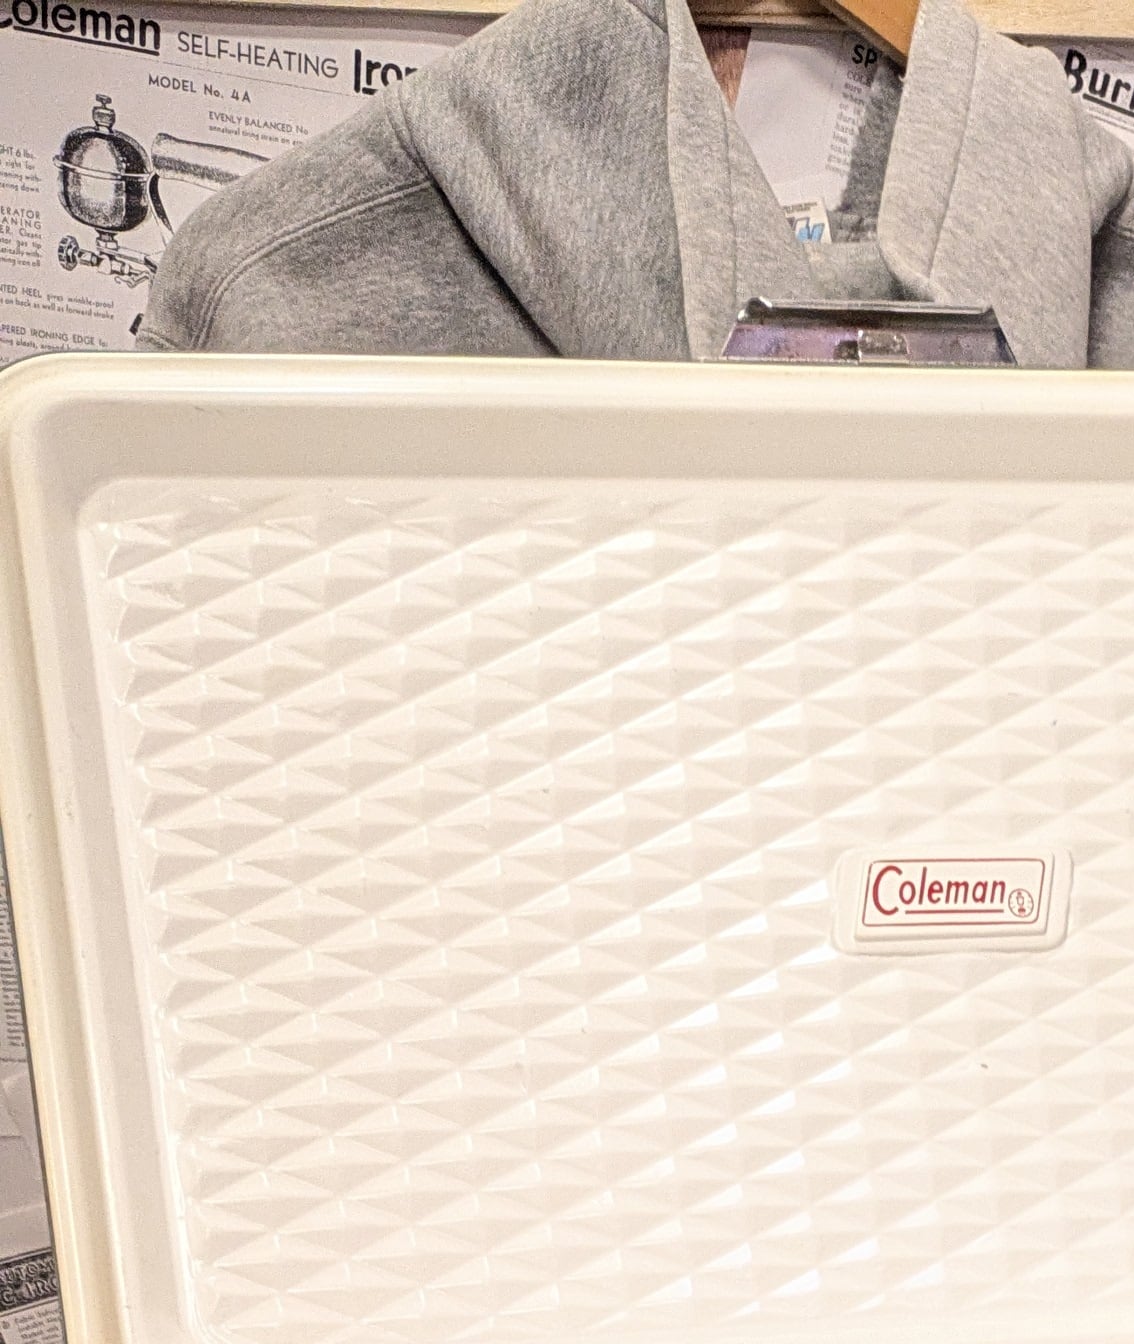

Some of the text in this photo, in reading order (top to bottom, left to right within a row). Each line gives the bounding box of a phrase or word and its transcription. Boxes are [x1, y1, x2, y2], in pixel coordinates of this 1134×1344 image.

[0, 0, 161, 50] oleman
[177, 31, 339, 79] SELF-HEATING
[148, 73, 197, 94] MODEL
[203, 84, 225, 99] No.
[208, 111, 242, 125] EVENLY
[244, 117, 293, 134] BALANCED
[30, 328, 69, 342] IRONING
[72, 334, 95, 346] EDGE
[872, 865, 1006, 915] Coleman
